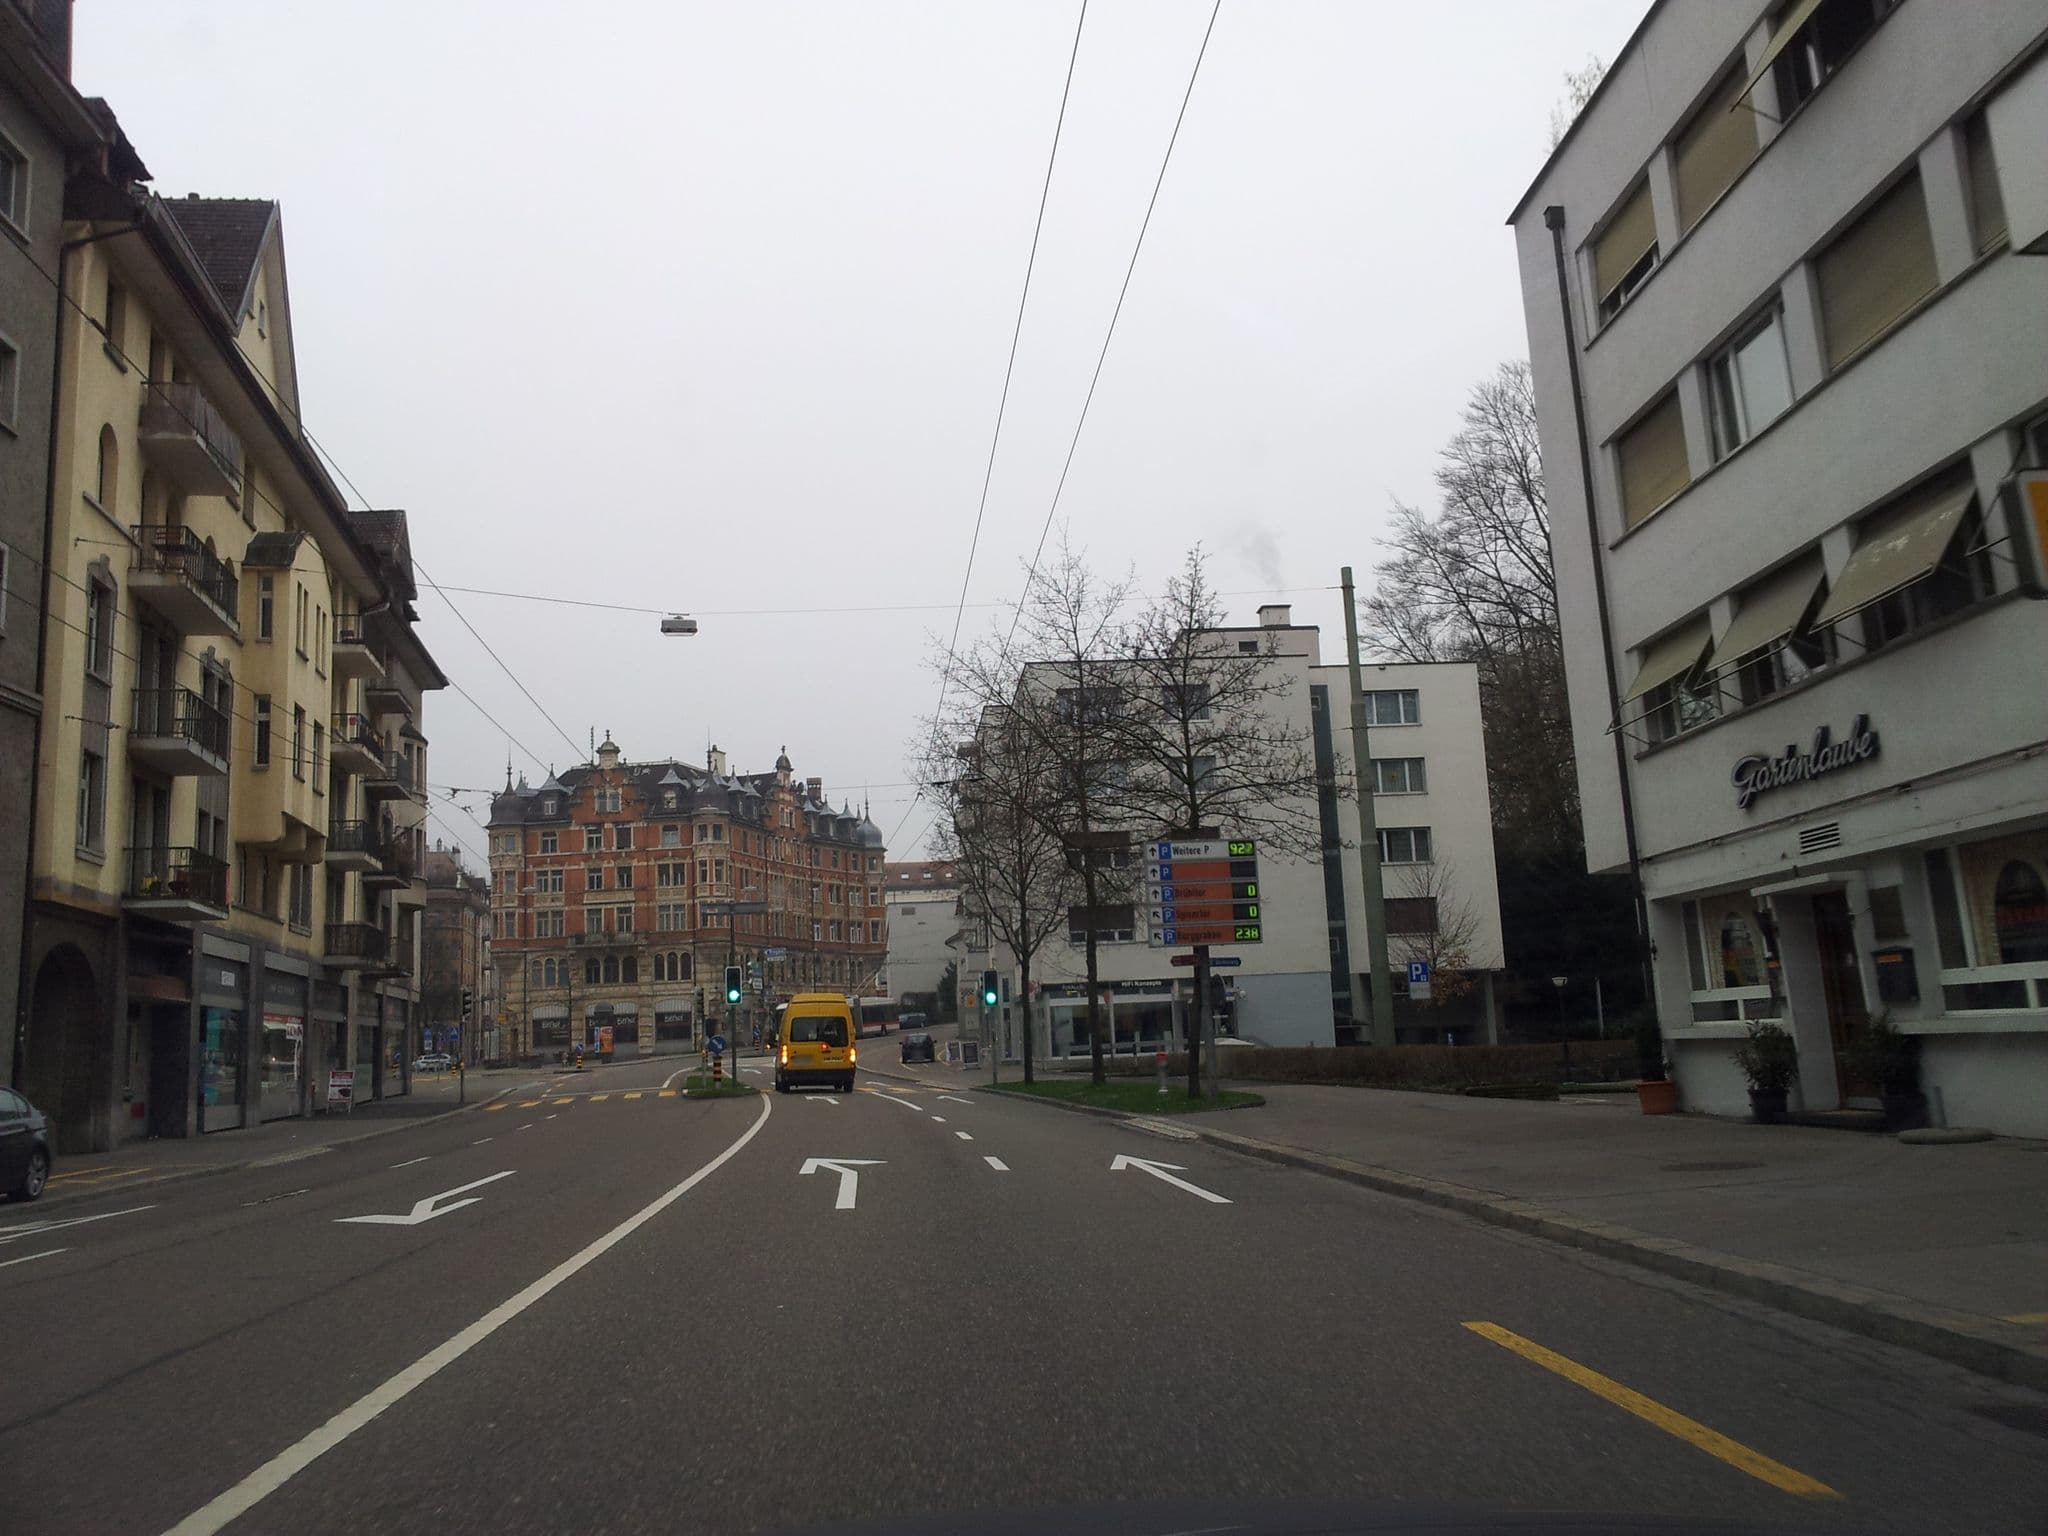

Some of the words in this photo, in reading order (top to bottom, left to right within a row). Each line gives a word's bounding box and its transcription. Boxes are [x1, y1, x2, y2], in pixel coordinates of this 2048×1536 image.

[1731, 713, 1880, 809] Gartenlaube
[1172, 846, 1201, 856] Weitere
[1204, 845, 1209, 854] P
[1248, 885, 1256, 896] 0
[1250, 906, 1257, 917] 0
[1236, 928, 1259, 939] 238
